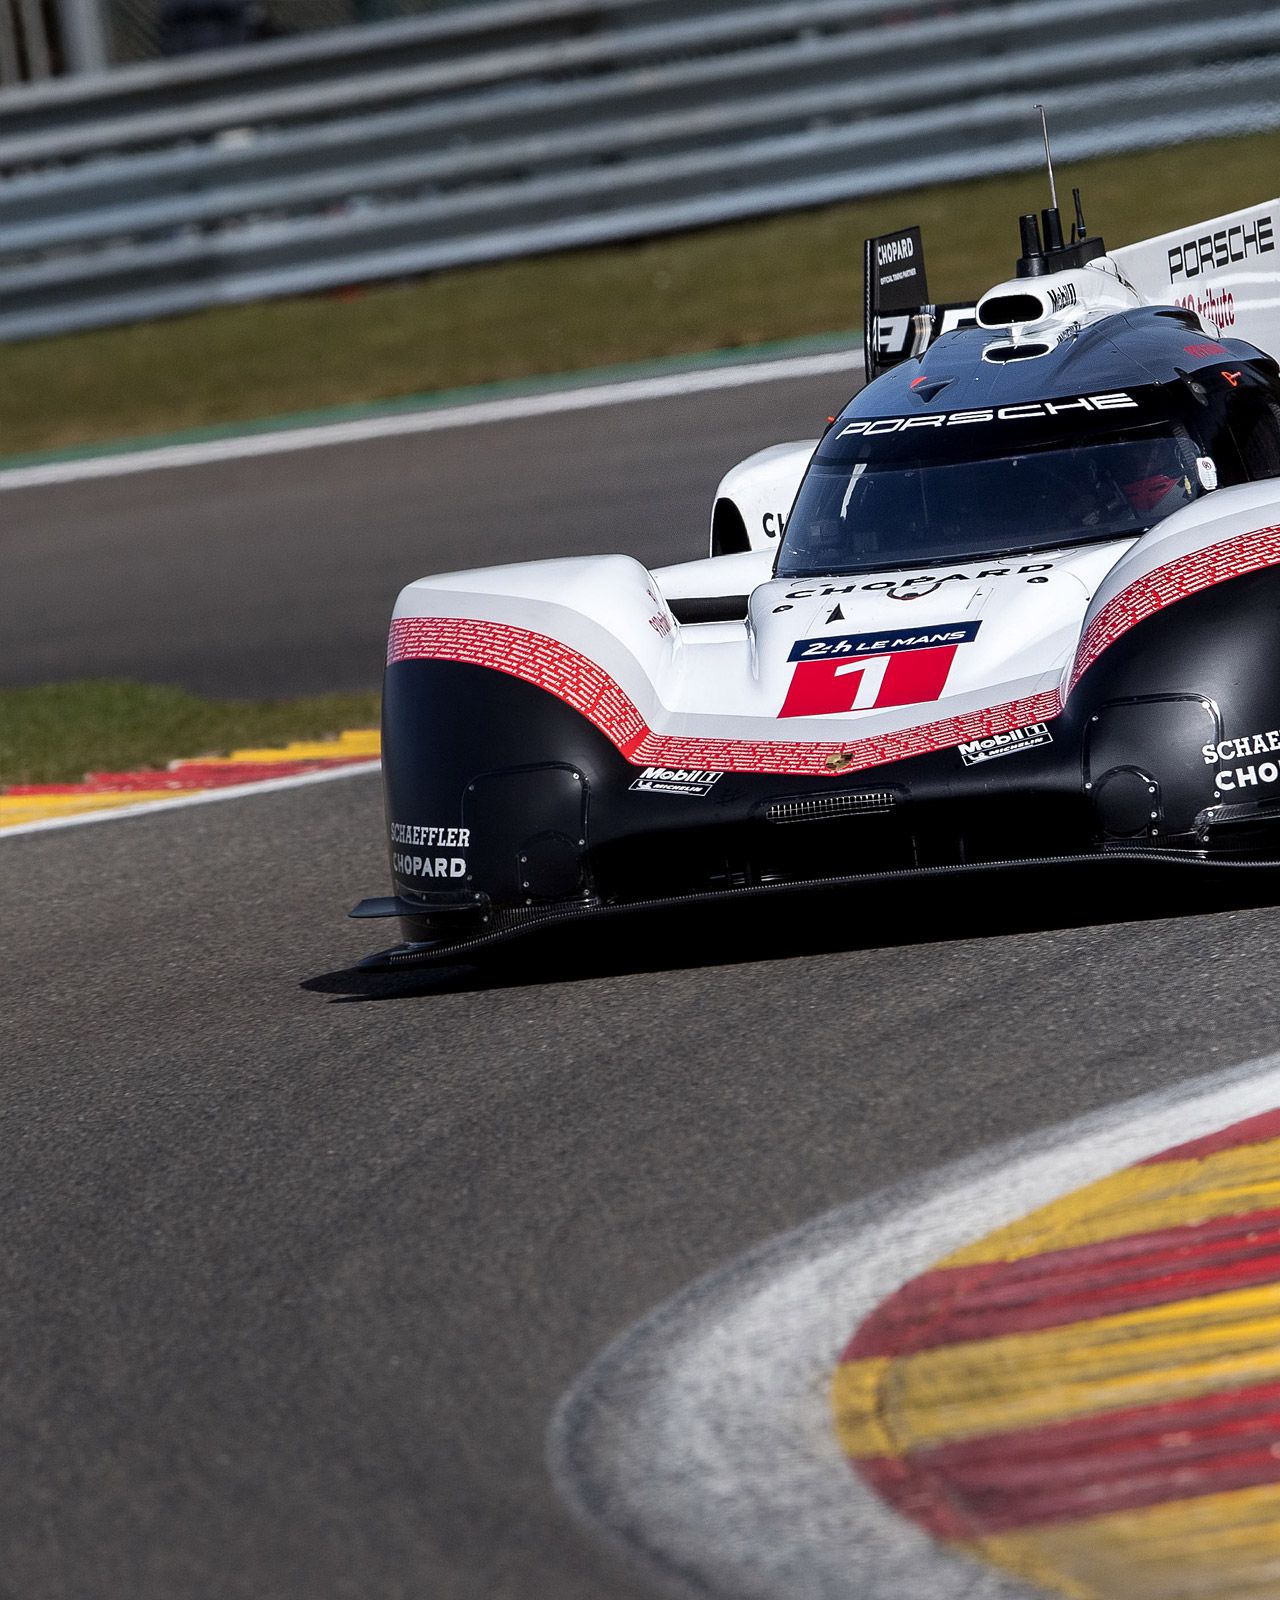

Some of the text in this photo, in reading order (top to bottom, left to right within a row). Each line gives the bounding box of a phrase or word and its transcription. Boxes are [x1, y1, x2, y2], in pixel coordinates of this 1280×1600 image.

[877, 237, 914, 266] CHOPARD
[1167, 216, 1275, 285] PORSCHE
[835, 392, 1138, 440] PORSCHE
[785, 563, 1053, 599] CHOPARD
[856, 639, 891, 651] LE
[891, 630, 967, 648] MANS
[834, 655, 892, 711] 1
[958, 729, 1024, 755] Mobil
[989, 737, 1044, 756] MICHELIN
[639, 766, 702, 784] Mobil
[652, 783, 704, 793] MICHELIN
[391, 823, 471, 847] SCHAEFFLER
[392, 852, 467, 878] CHOPARD
